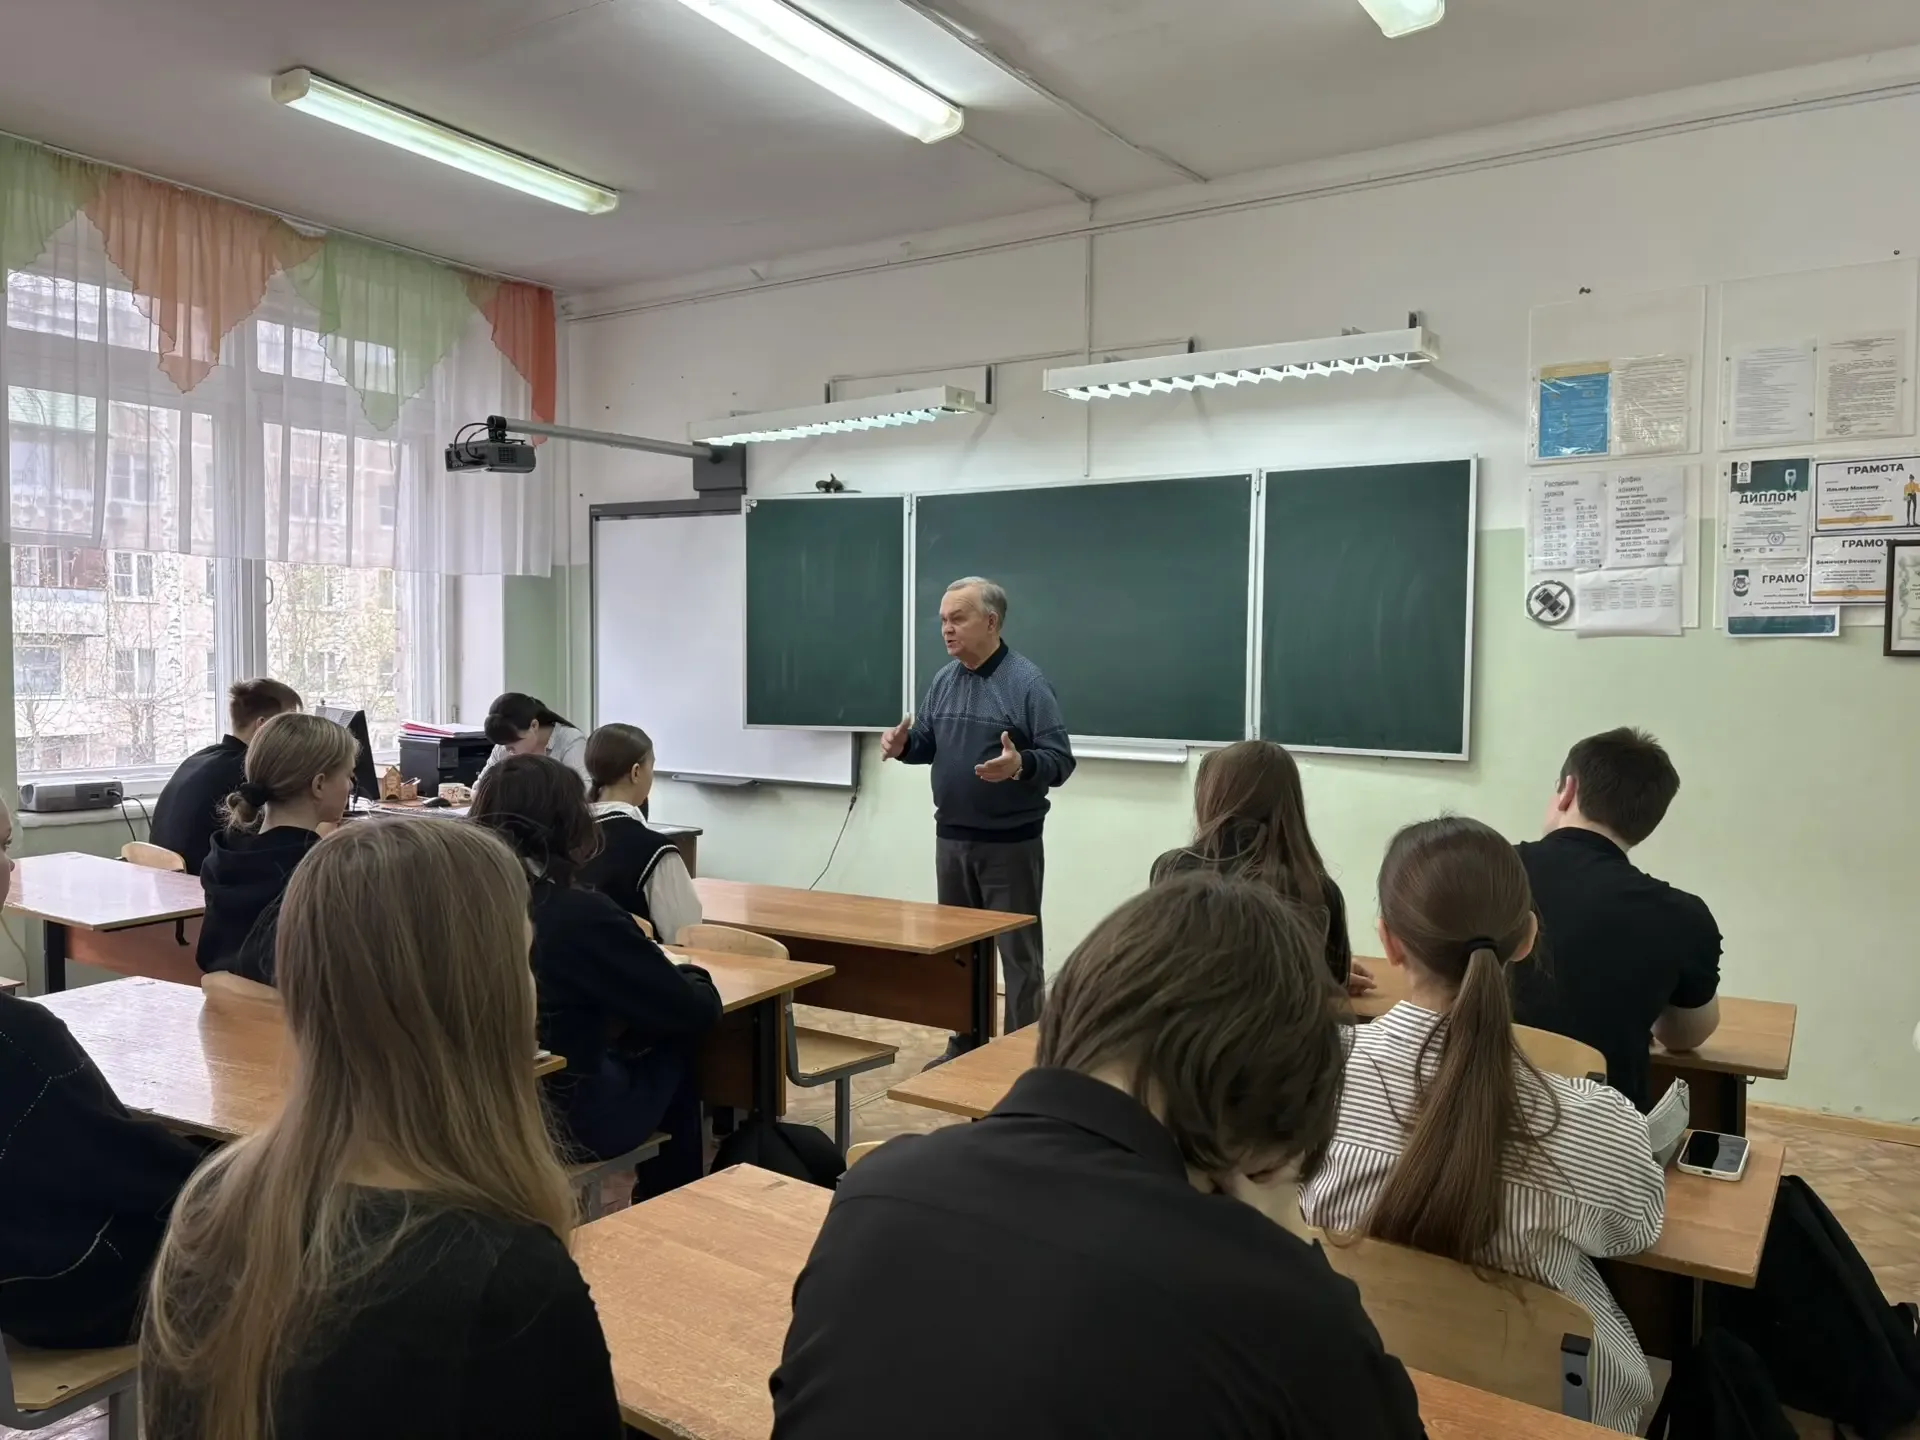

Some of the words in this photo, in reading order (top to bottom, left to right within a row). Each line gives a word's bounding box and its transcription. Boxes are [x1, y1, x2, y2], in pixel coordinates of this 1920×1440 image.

[1847, 463, 1905, 475] ГРАМОТА
[1739, 492, 1797, 505] ДИПЛОМ
[1842, 538, 1894, 548] ГРАМОТ
[1762, 573, 1808, 584] ГРАМО
